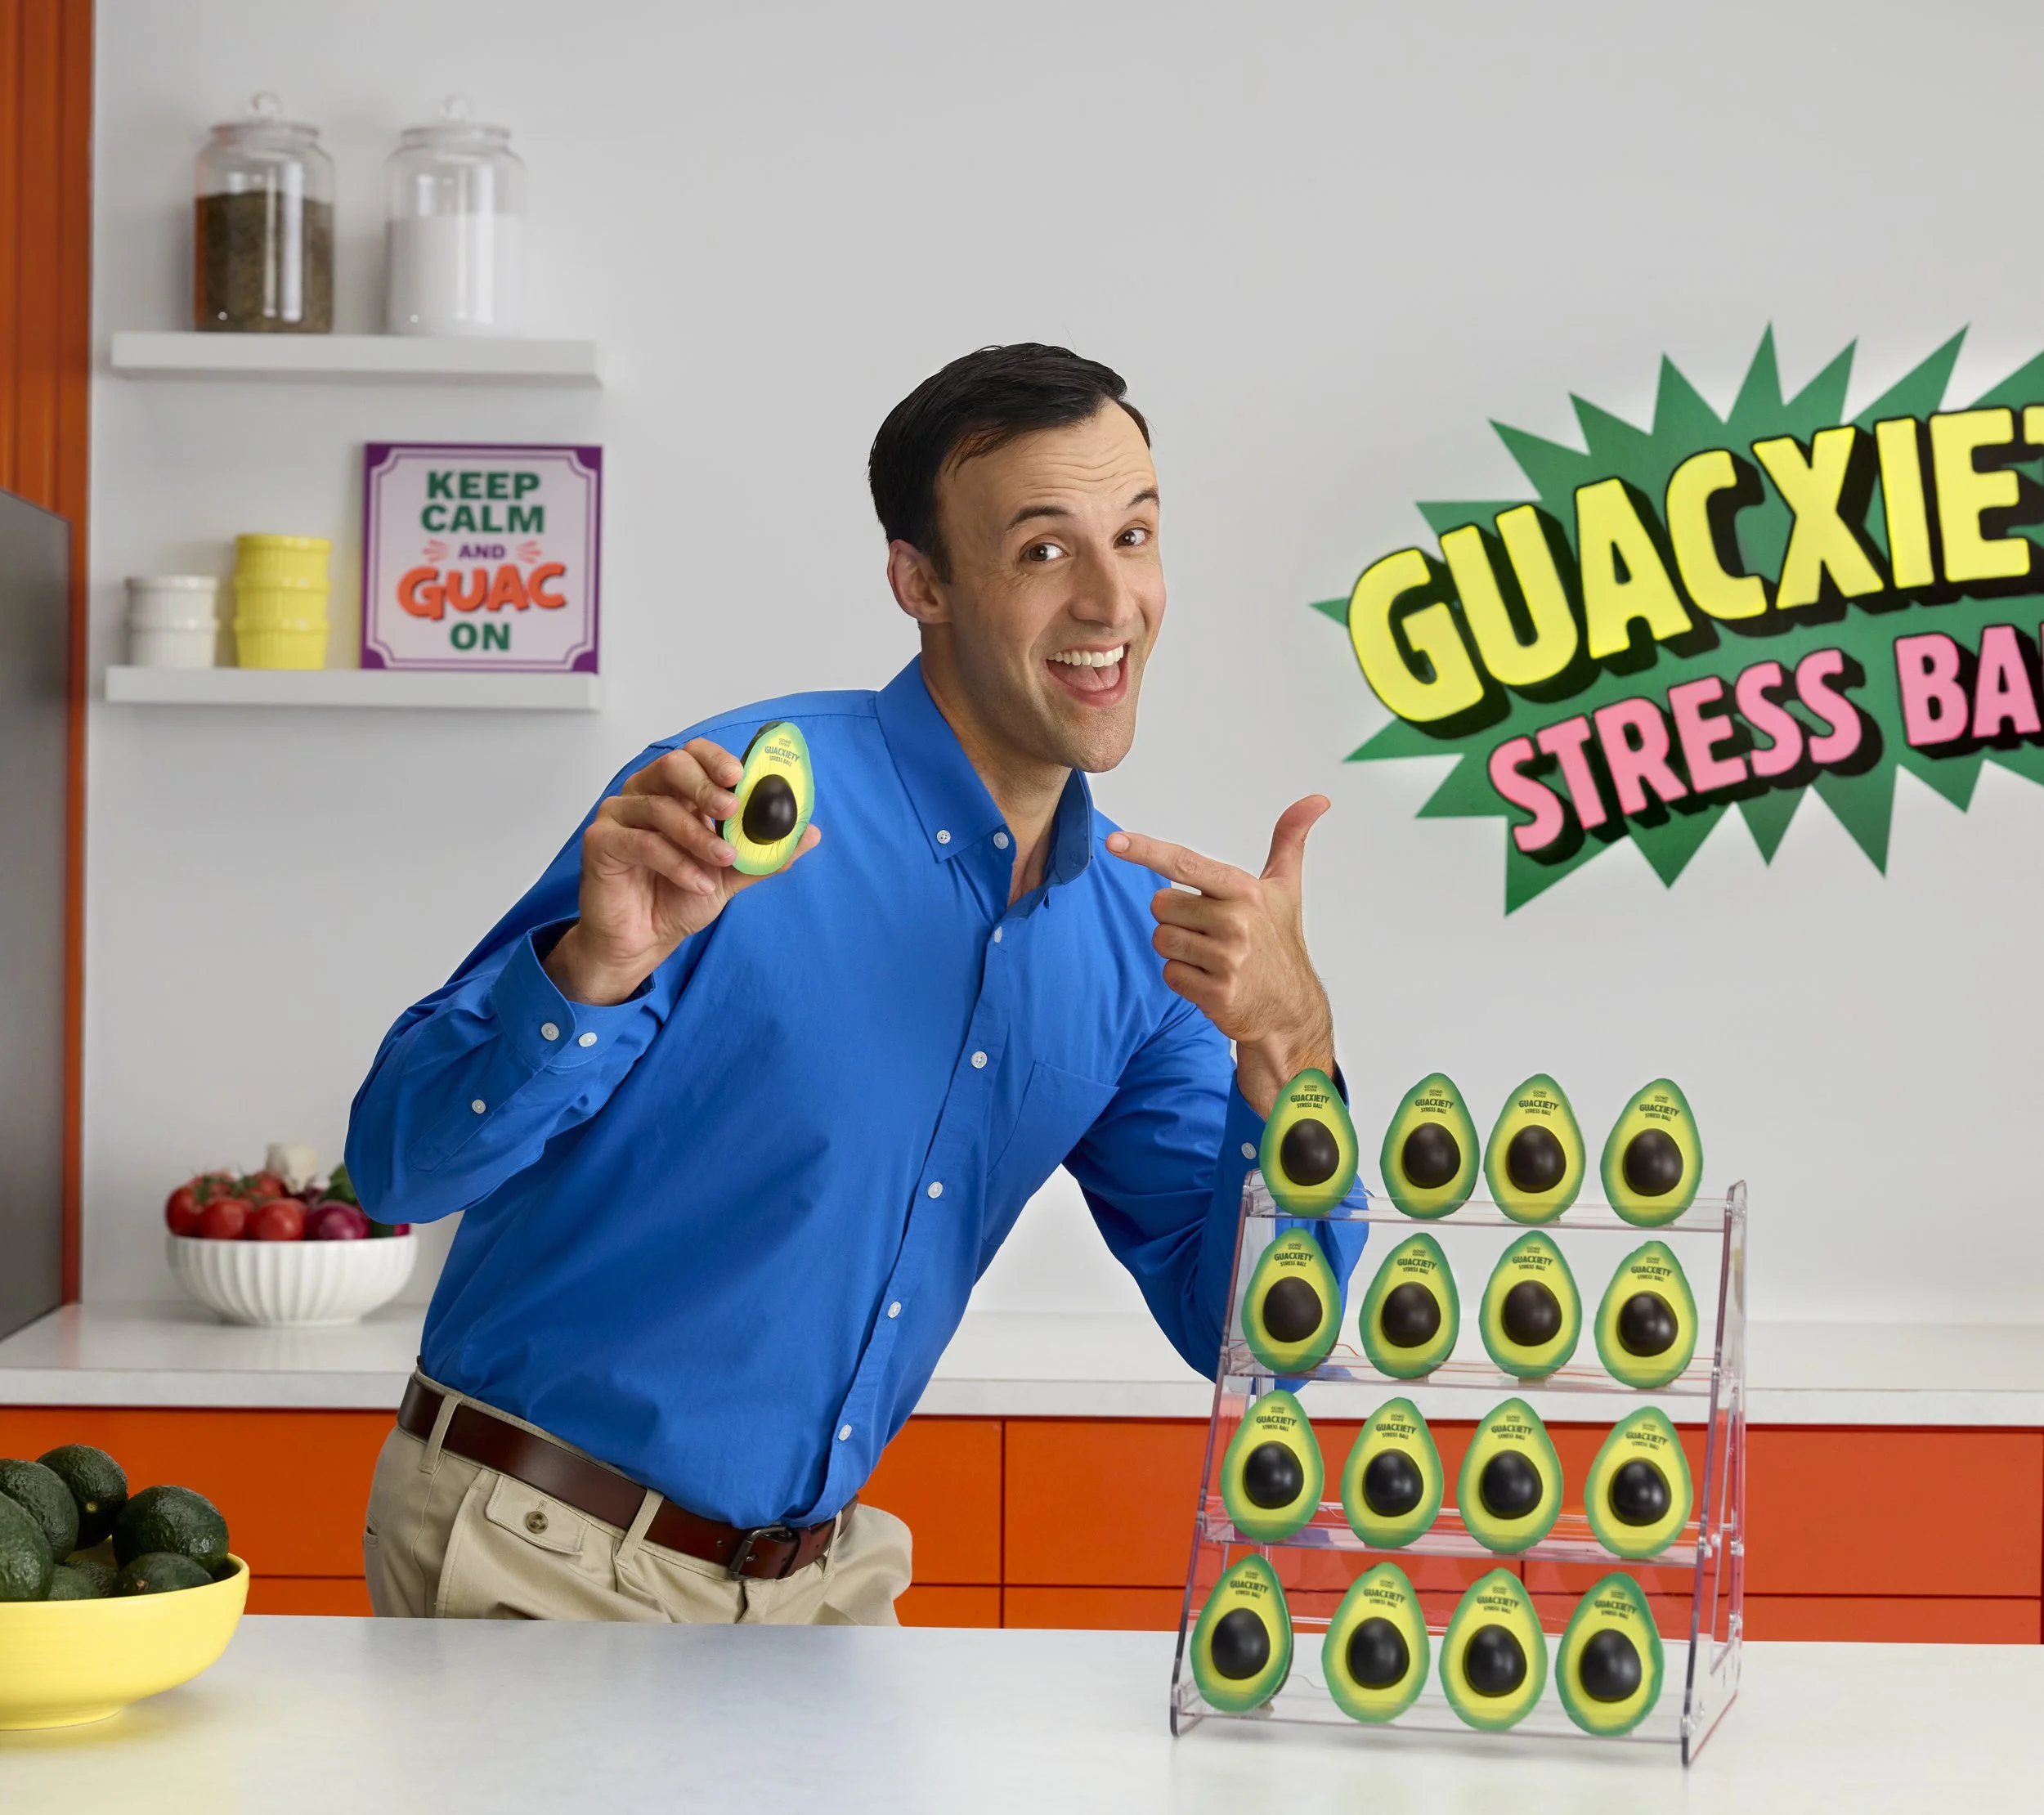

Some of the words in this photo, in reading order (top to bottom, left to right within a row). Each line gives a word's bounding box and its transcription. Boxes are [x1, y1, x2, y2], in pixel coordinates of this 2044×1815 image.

[427, 471, 540, 500] KEEP
[420, 504, 545, 533] CALM
[459, 544, 506, 559] AND
[1347, 406, 2044, 723] GUACXIE
[397, 562, 567, 621] GUAC
[450, 623, 510, 651] ON
[1486, 648, 1862, 853] STRESS
[1894, 622, 2044, 747] BA
[765, 746, 800, 762] GUACXIETY
[783, 759, 792, 767] BALL
[1290, 1094, 1329, 1104] GUACXIETY
[1415, 1099, 1454, 1109] GUACXIETY
[1519, 1100, 1558, 1110] GUACXIETY
[1639, 1105, 1680, 1116] GUACXIETY
[1274, 1253, 1313, 1262] GUACXIETY
[1513, 1256, 1553, 1266] GUACXIETY
[1397, 1259, 1437, 1269] GUACXIETY
[1631, 1266, 1672, 1276] GUACXIETY
[1256, 1416, 1297, 1426] GUACXIETY
[1376, 1424, 1416, 1434] GUACXIETY
[1491, 1425, 1533, 1434] GUACXIETY
[1625, 1432, 1668, 1445] GUACXIETY
